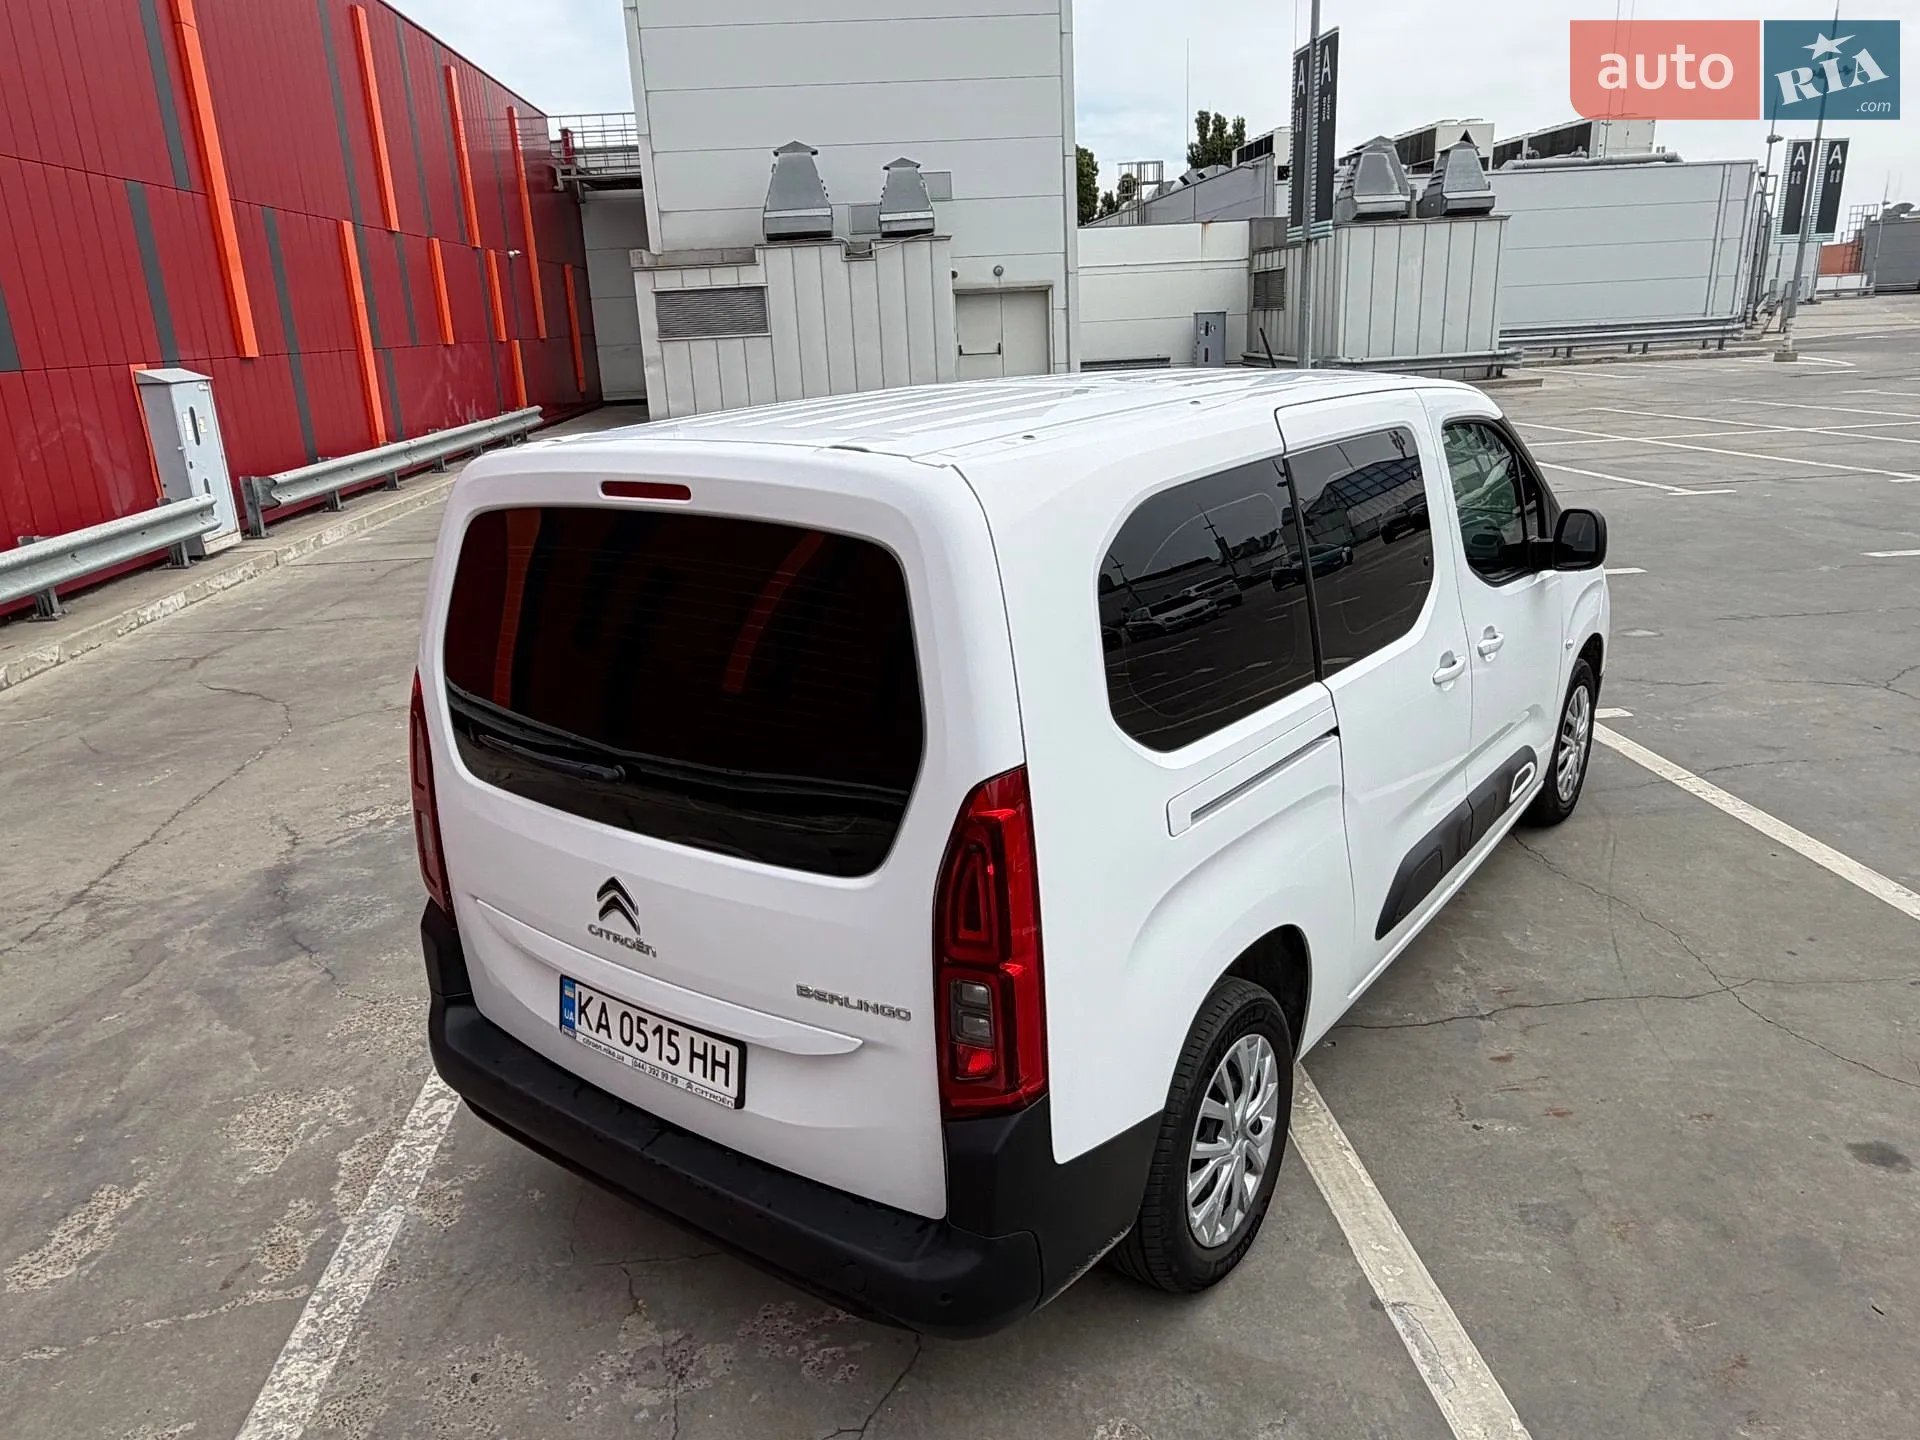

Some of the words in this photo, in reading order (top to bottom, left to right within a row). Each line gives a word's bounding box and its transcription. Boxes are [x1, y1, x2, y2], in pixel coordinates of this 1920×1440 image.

[1296, 59, 1306, 98] A
[1320, 44, 1331, 85] A
[1793, 145, 1806, 166] A
[1828, 144, 1842, 165] A
[564, 1007, 574, 1023] UA
[796, 983, 912, 1022] BERLINGO
[577, 991, 612, 1040] KA
[619, 1010, 680, 1066] 0515
[689, 1036, 731, 1088] HH
